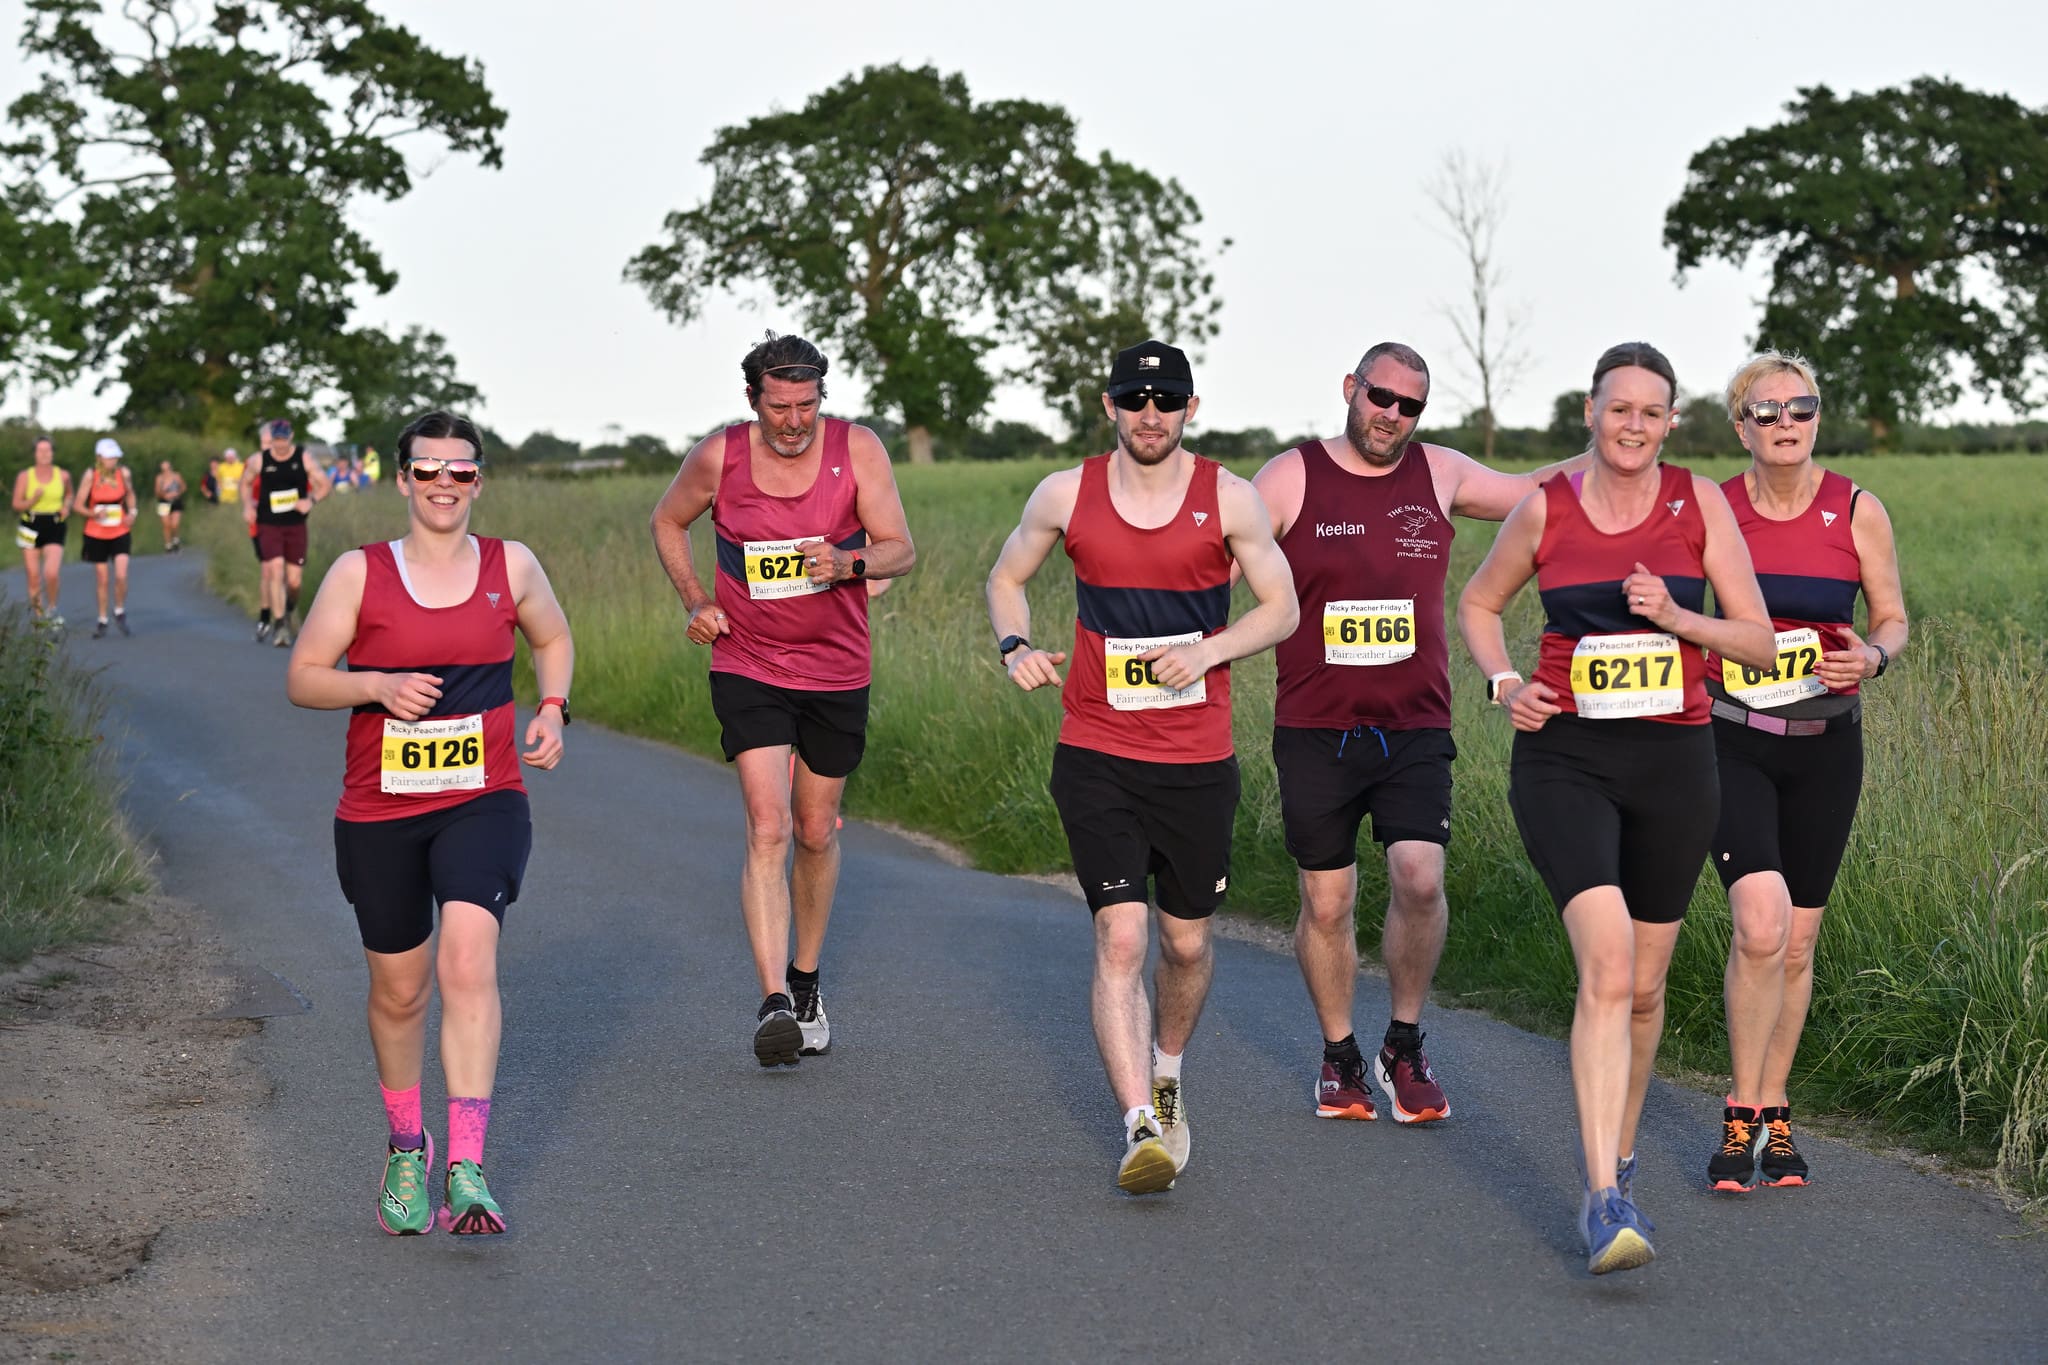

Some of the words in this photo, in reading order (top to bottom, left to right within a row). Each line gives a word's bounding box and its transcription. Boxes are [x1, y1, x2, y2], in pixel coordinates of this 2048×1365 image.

[1387, 506, 1404, 518] THE
[1404, 505, 1438, 522] SAXONS
[1316, 522, 1365, 538] Keelan
[760, 554, 805, 580] 627
[1340, 618, 1410, 643] 6166
[1638, 640, 1664, 648] Friday
[1782, 635, 1805, 644] Friday
[1332, 650, 1384, 659] Fairweather
[1588, 656, 1674, 690] 6217
[1742, 648, 1816, 685] 6472
[1116, 692, 1176, 703] Fairweather
[391, 725, 411, 735] Ricky
[402, 737, 478, 769] 6126
